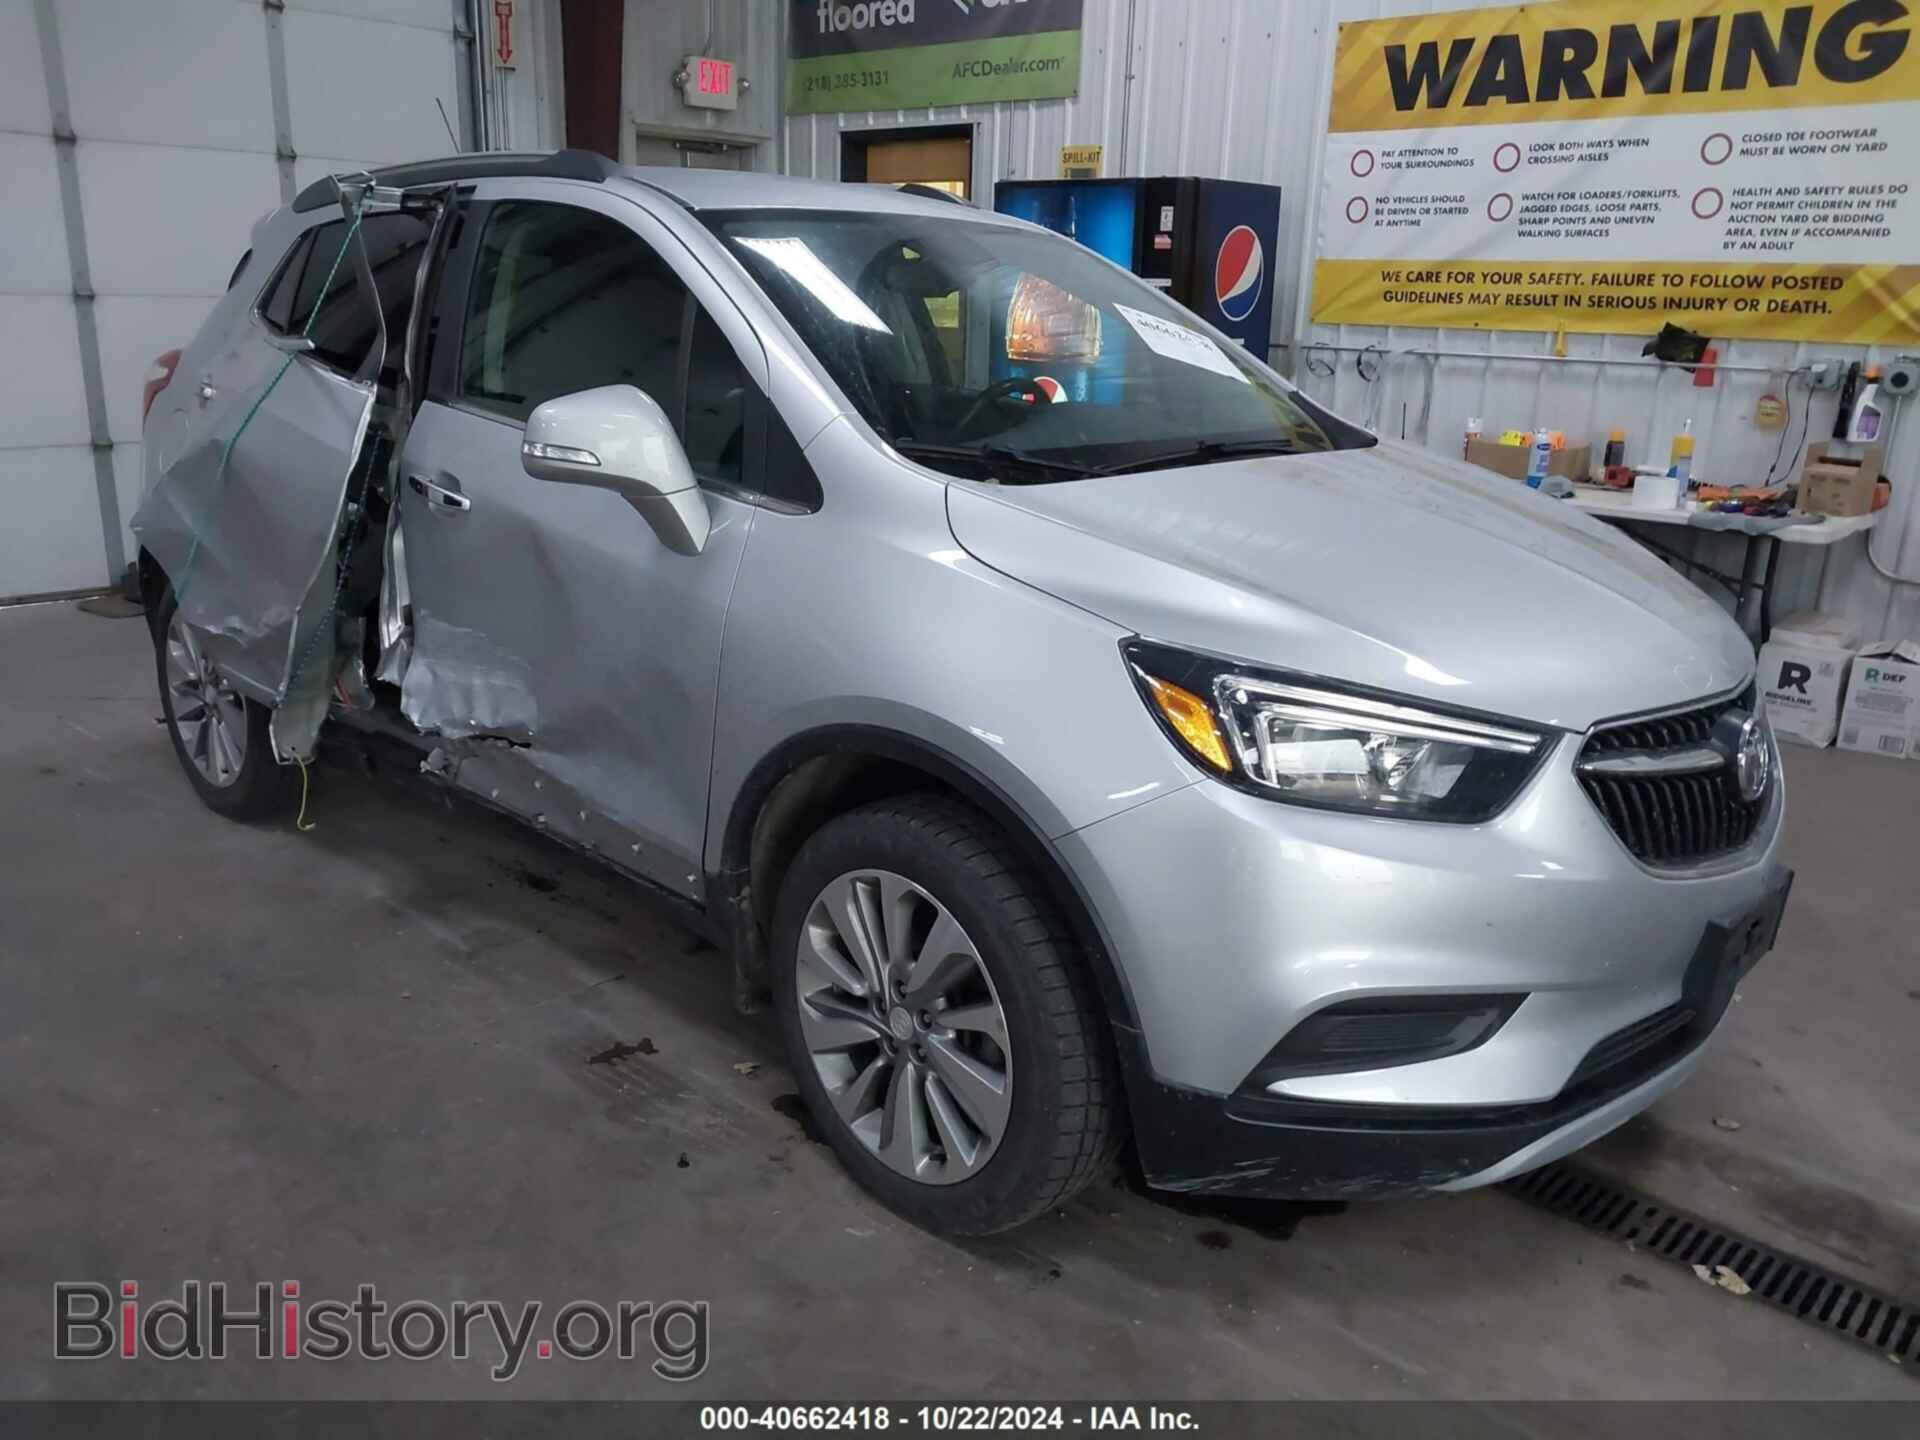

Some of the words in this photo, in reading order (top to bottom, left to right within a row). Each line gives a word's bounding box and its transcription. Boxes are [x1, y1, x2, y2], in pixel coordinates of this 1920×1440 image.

[817, 0, 915, 33] floored
[1384, 0, 1911, 111] WARNING
[700, 61, 732, 94] EXIT
[1742, 132, 1782, 143] CLOSED
[1786, 132, 1805, 141] TOE
[1809, 128, 1877, 140] FOOTWEAR
[1529, 143, 1555, 152] LOOK
[1559, 142, 1584, 150] BOTH
[1586, 140, 1614, 149] WAYS
[1618, 138, 1650, 147] WHEN
[1739, 146, 1769, 156] MUST
[1772, 145, 1785, 155] BE
[1789, 145, 1826, 155] WORN
[1830, 143, 1851, 153] ON
[1855, 142, 1888, 152] YARD
[1448, 147, 1458, 155] TO
[1063, 151, 1101, 164] SPILL-KIT
[1528, 155, 1575, 164] CROSSING
[1577, 153, 1609, 162] AISLES
[1381, 161, 1402, 169] YOUR
[1406, 159, 1475, 168] SURROUNDINGS
[1522, 192, 1554, 201] WATCH
[1557, 192, 1576, 200] FOR
[1579, 189, 1680, 200] LOADERS/FORKLIFTS,
[1732, 187, 1772, 196] HEALTH
[1775, 187, 1800, 196] AND
[1804, 186, 1845, 195] SAFETY
[1848, 185, 1884, 194] RULES
[1888, 184, 1908, 194] DO
[1376, 196, 1390, 204] NO
[1392, 196, 1428, 204] VEHICLES
[1431, 195, 1465, 203] SHOULD
[1730, 201, 1753, 210] NOT
[1756, 201, 1794, 210] PERMIT
[1798, 200, 1853, 209] CHILDREN
[1857, 200, 1871, 209] IN
[1875, 199, 1898, 208] THE
[1375, 208, 1384, 216] BE
[1387, 207, 1417, 215] DRIVEN
[1419, 207, 1430, 215] OR
[1433, 206, 1469, 215] STARTED
[1520, 204, 1557, 213] JAGGED
[1560, 204, 1592, 213] EDGES,
[1596, 203, 1626, 212] LOOSE
[1629, 202, 1662, 212] PARTS,
[1518, 217, 1549, 225] SHARP
[1552, 217, 1587, 225] POINTS
[1589, 216, 1611, 224] AND
[1614, 216, 1655, 224] UNEVEN
[1728, 215, 1776, 224] AUCTION
[1780, 215, 1808, 223] YARD
[1813, 215, 1829, 223] OR
[1833, 214, 1884, 223] BIDDING
[1517, 230, 1561, 238] WALKING
[1564, 229, 1610, 237] SURFACES
[1725, 228, 1756, 238] AREA,
[1760, 228, 1788, 237] EVEN
[1792, 228, 1801, 236] IF
[1804, 227, 1891, 237] ACCOMPANIED
[1723, 241, 1737, 250] BY
[1740, 241, 1757, 250] AN
[1760, 241, 1794, 250] ADULT
[1381, 271, 1402, 282] WE
[1406, 271, 1441, 283] CARE
[1447, 272, 1475, 283] FOR
[1480, 272, 1523, 285] YOUR
[1528, 273, 1585, 286] SAFETY.
[1591, 272, 1655, 288] FAILURE
[1662, 274, 1684, 287] TO
[1690, 274, 1765, 288] FOLLOW
[1771, 276, 1844, 291] POSTED
[1383, 290, 1464, 304] GUIDELINES
[1468, 293, 1501, 306] MAY
[1505, 294, 1559, 307] RESULT
[1563, 295, 1582, 307] IN
[1587, 294, 1658, 311] SERIOUS
[1663, 296, 1728, 310] INJURY
[1734, 298, 1761, 312] OR
[1766, 299, 1832, 314] DEATH.
